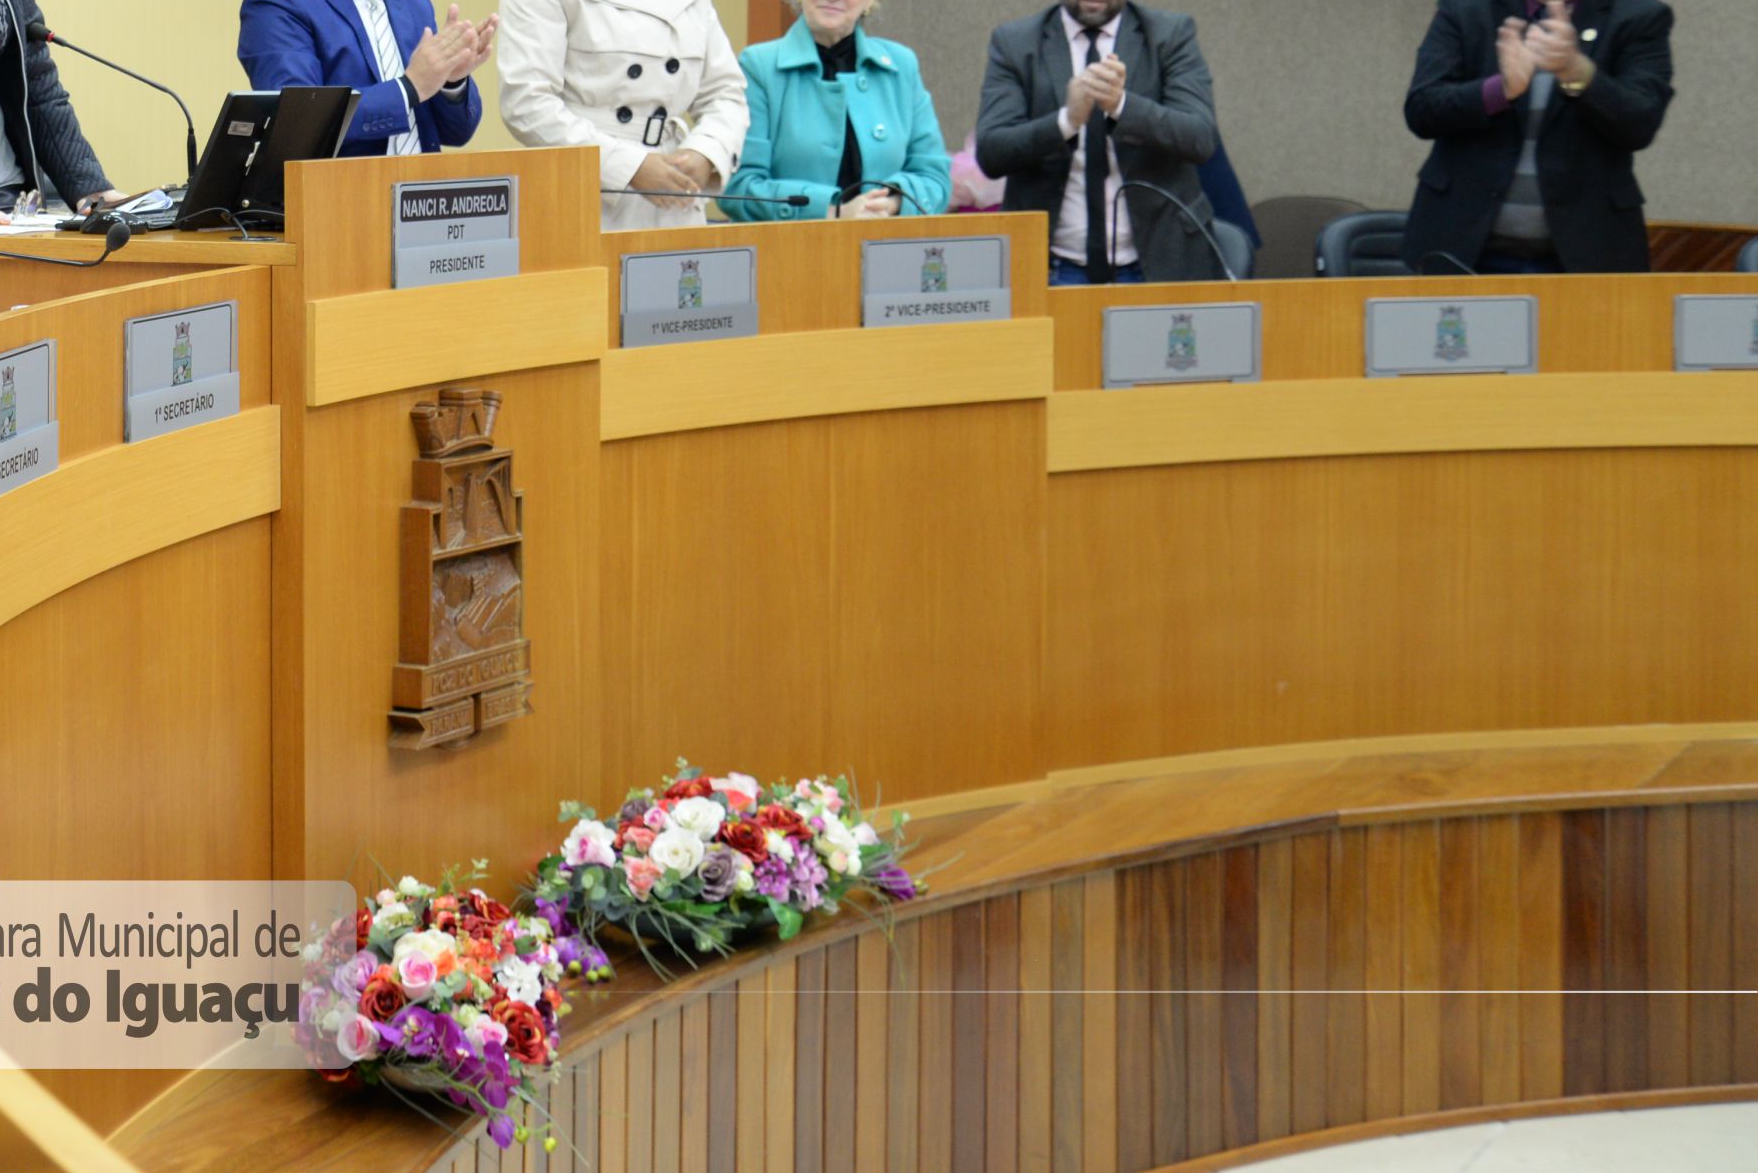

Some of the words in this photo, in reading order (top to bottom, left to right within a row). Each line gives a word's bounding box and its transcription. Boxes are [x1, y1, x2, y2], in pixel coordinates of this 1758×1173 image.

[402, 198, 437, 218] NANCI
[438, 197, 450, 215] R.
[451, 193, 507, 214] ANDREOLA
[447, 224, 465, 240] PDT
[429, 255, 485, 274] PRESIDENTE
[897, 300, 991, 317] VICE-PRESIDENTE
[660, 316, 734, 334] VICE-PRESIDENTE
[163, 391, 215, 422] SECRETÁRIO
